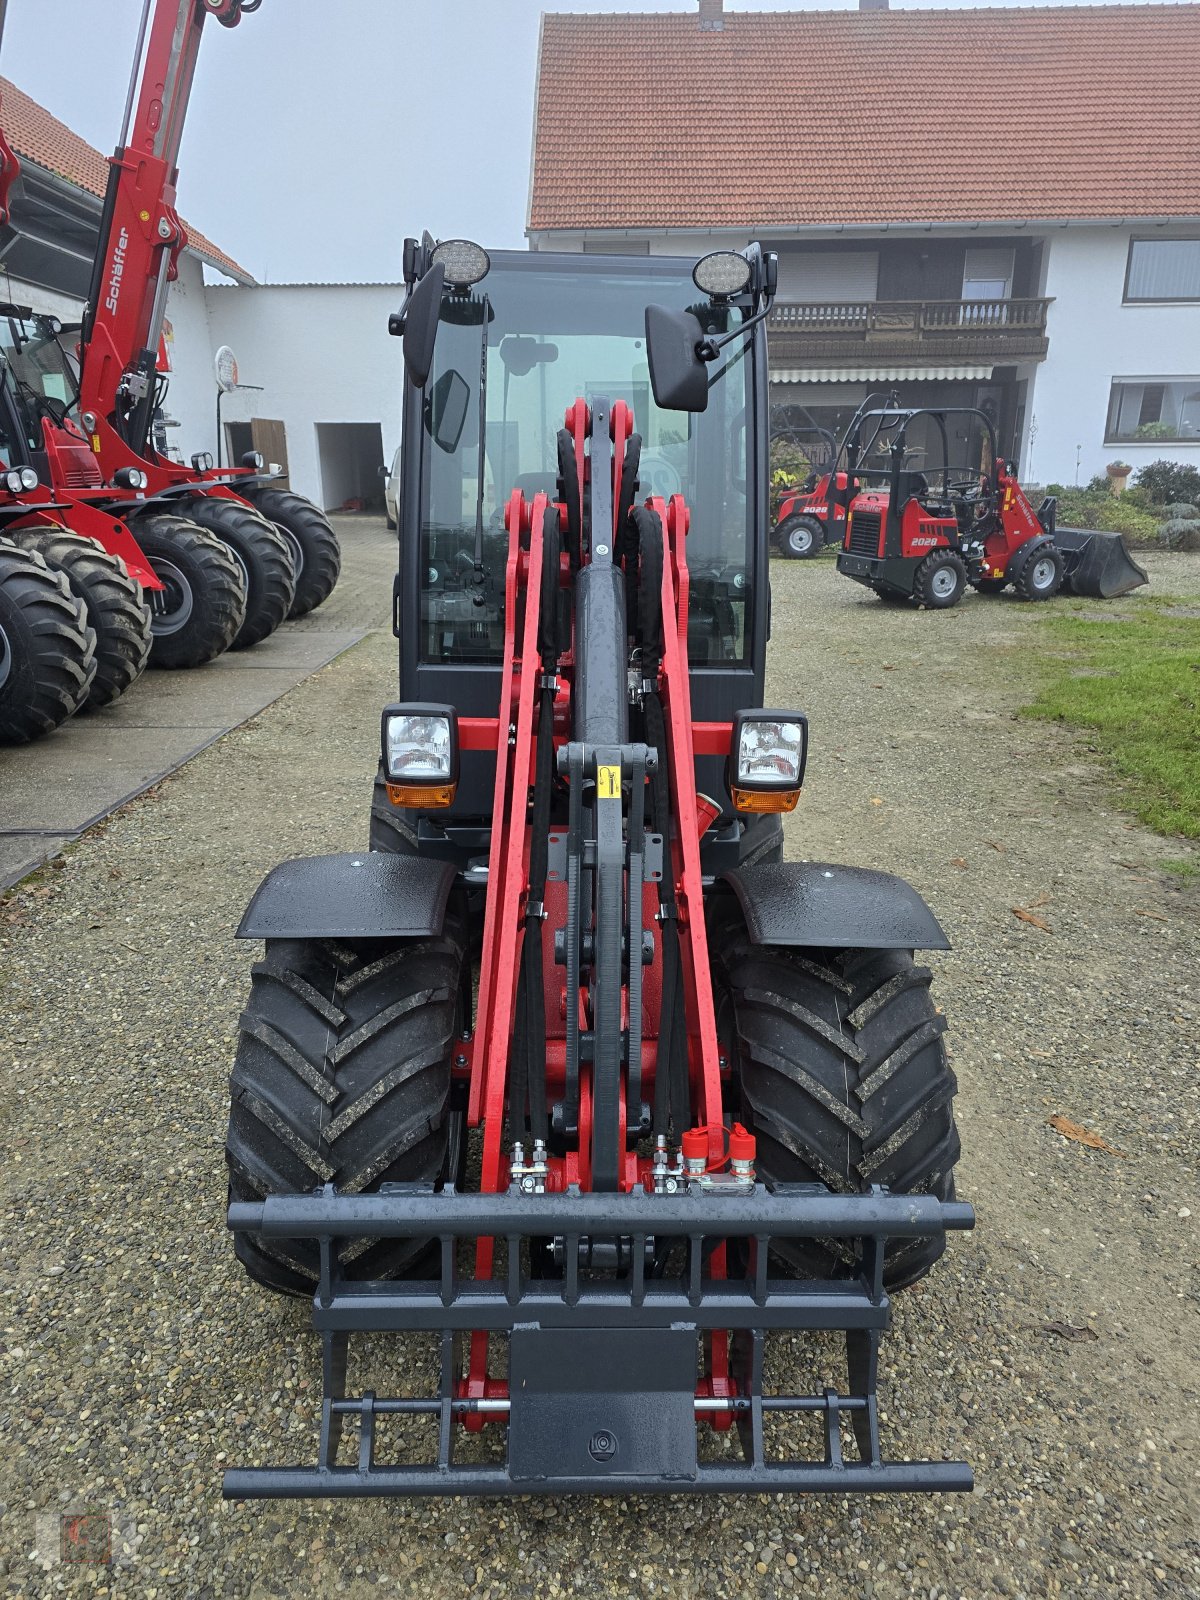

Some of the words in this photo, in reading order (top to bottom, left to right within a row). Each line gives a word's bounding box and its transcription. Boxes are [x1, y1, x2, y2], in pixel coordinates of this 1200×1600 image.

[105, 226, 129, 316] Schäffer
[803, 506, 828, 514] 2028
[911, 537, 938, 546] 2028
